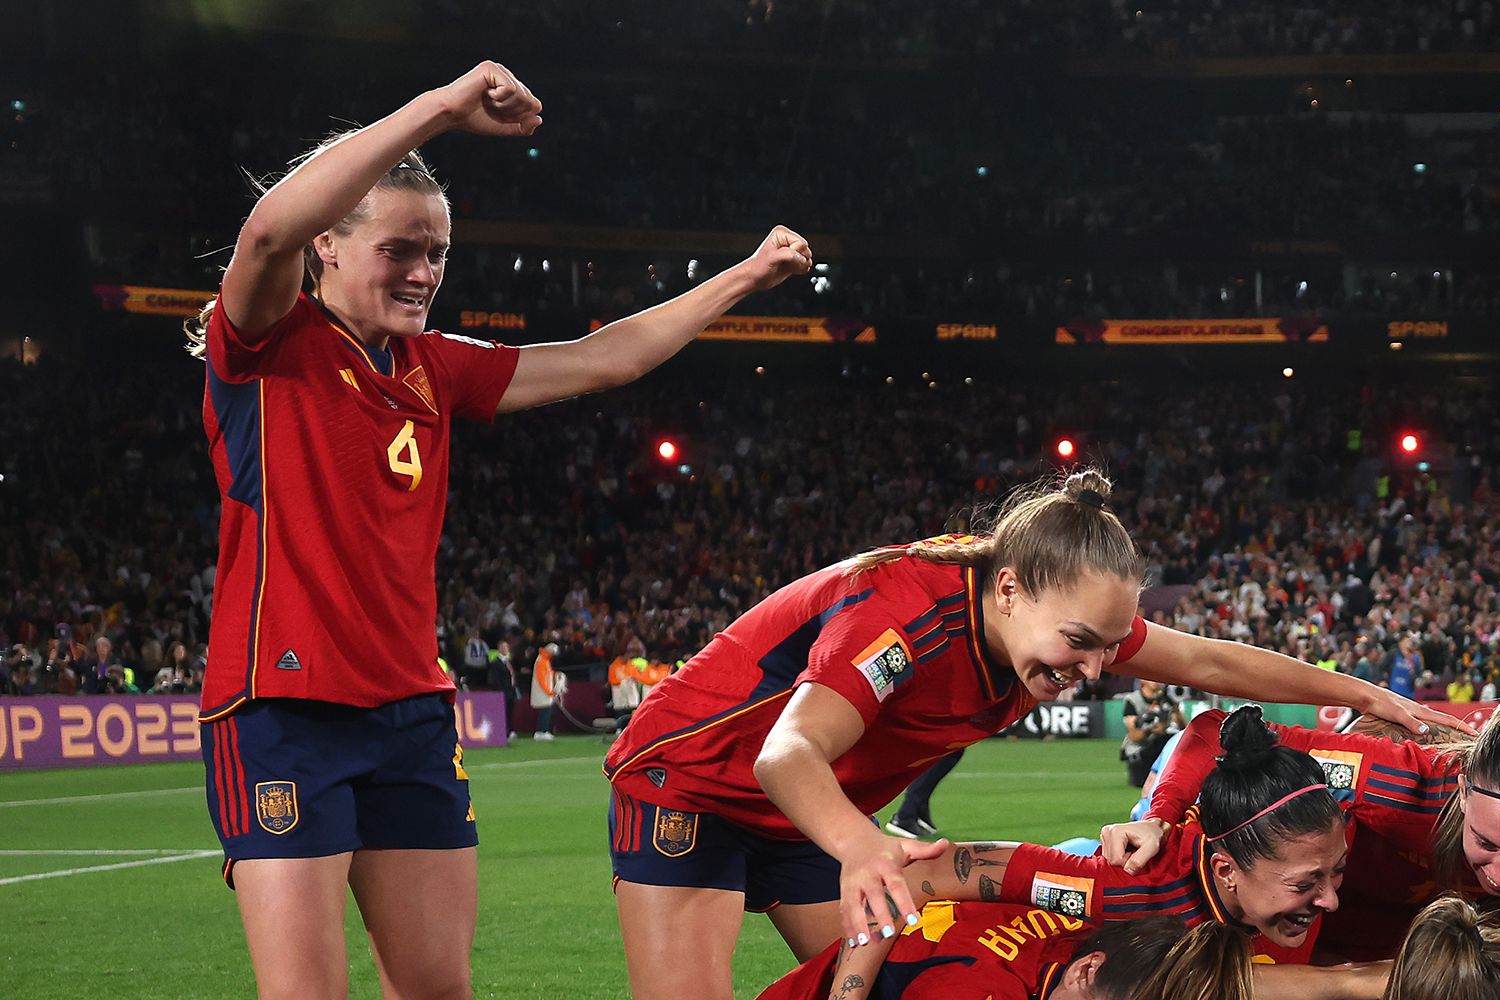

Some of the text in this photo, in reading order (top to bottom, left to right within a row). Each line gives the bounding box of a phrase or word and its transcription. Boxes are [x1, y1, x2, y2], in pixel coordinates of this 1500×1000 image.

[460, 311, 526, 329] SPAIN
[936, 324, 997, 340] SPAIN
[1120, 325, 1264, 336] CONGRATULATIONS
[1387, 321, 1448, 338] SPAIN
[60, 702, 200, 758] 2023
